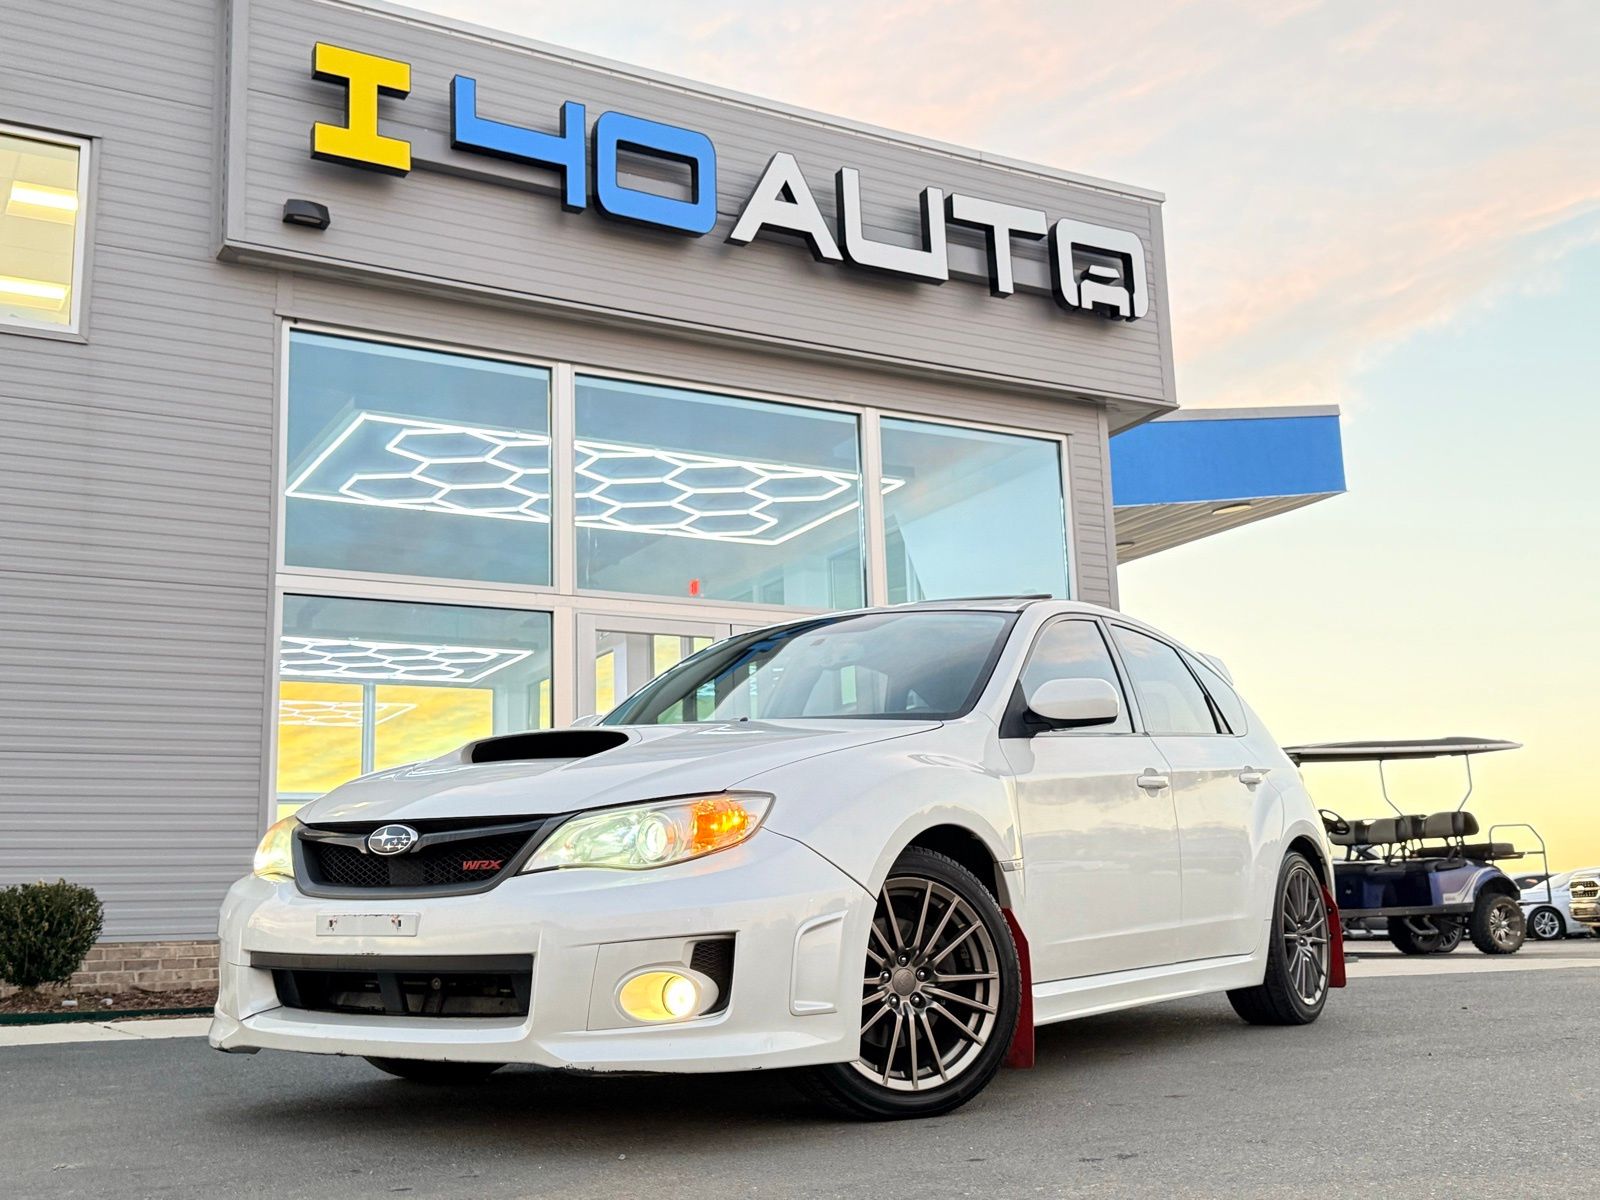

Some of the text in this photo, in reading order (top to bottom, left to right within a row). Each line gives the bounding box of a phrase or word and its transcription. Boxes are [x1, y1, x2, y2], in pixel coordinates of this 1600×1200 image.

[311, 41, 411, 177] I
[450, 74, 717, 236] 40
[462, 859, 503, 870] WRX
